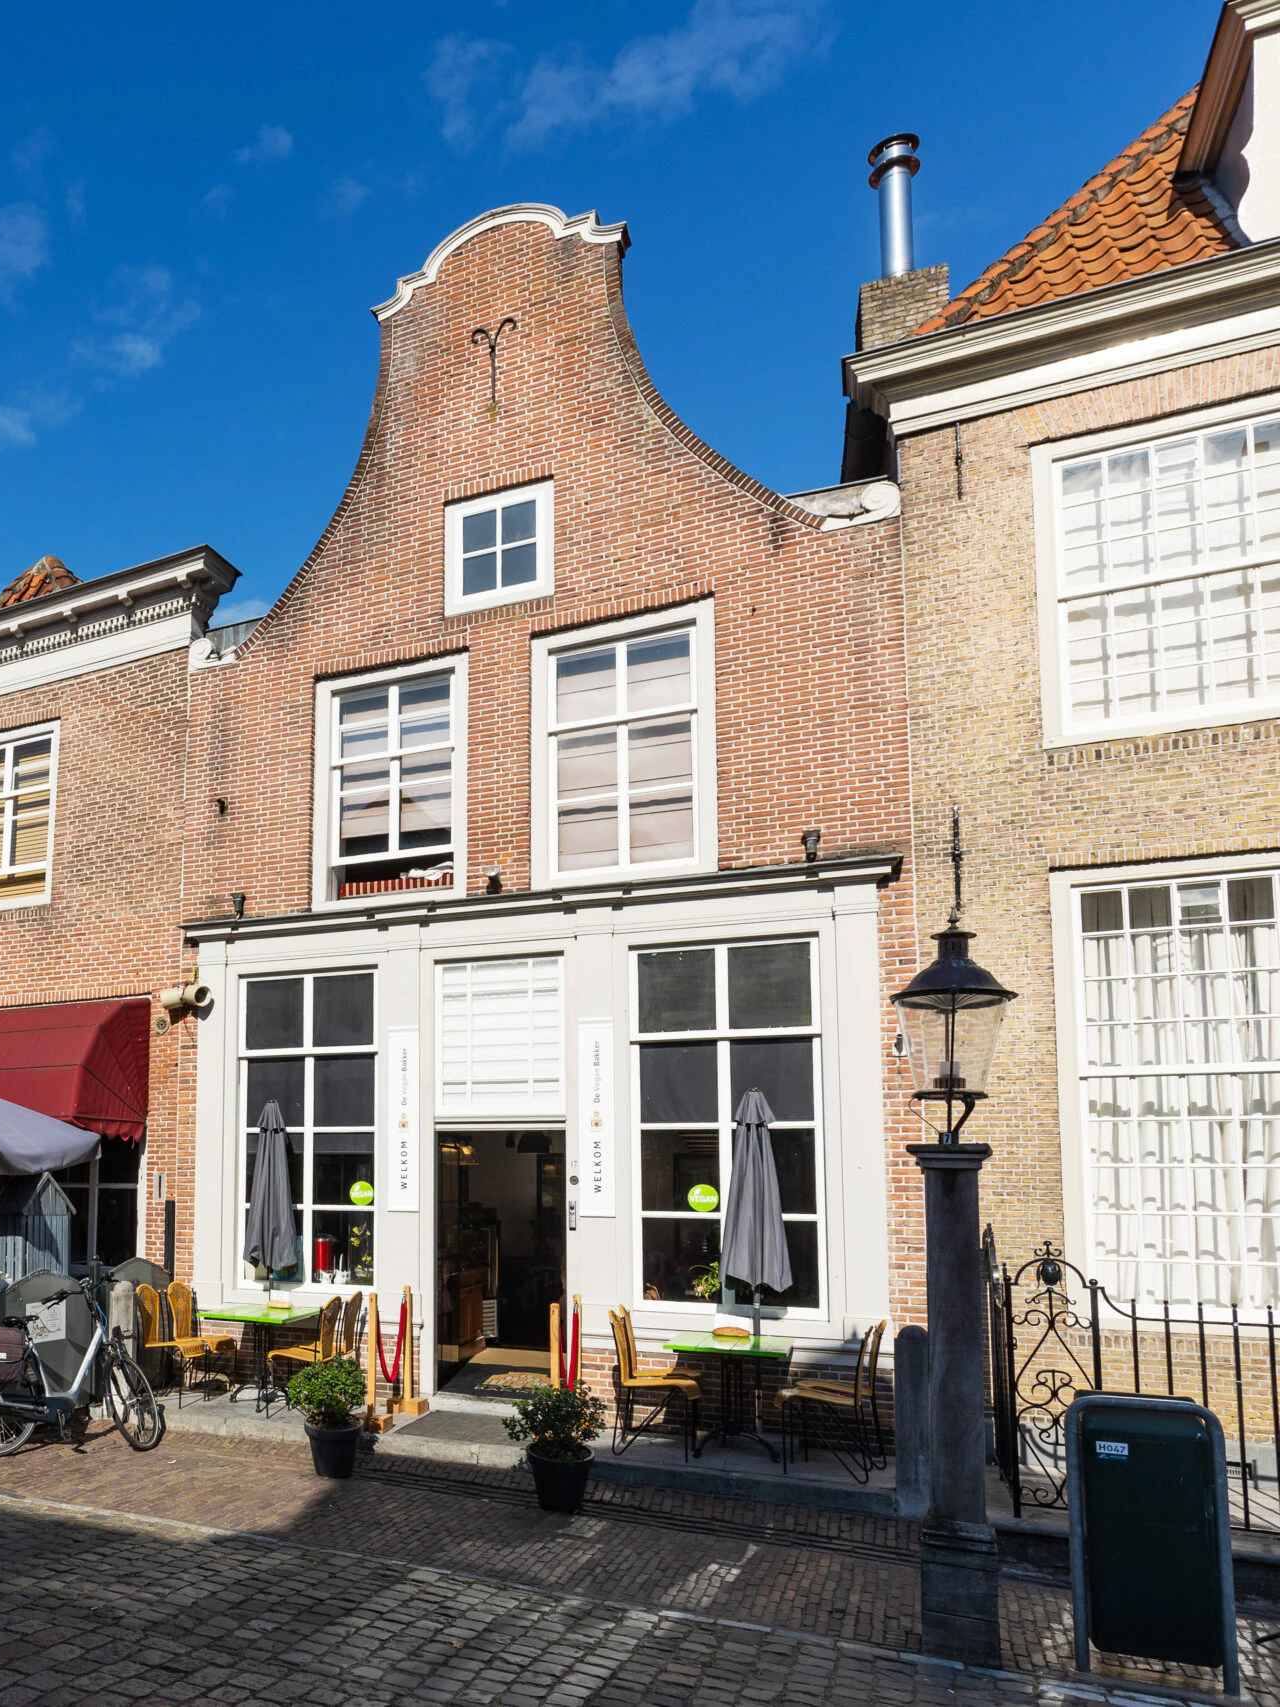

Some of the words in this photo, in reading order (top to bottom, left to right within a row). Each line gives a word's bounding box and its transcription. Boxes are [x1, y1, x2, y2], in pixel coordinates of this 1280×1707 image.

[593, 1068, 601, 1091] Vegan
[401, 1096, 407, 1106] De
[593, 1093, 600, 1103] De
[400, 1141, 408, 1190] WELKOM
[593, 1141, 602, 1193] WELKOM
[351, 1190, 373, 1198] VEGAN
[690, 1195, 717, 1203] VEGAN
[1098, 1443, 1126, 1454] H047
